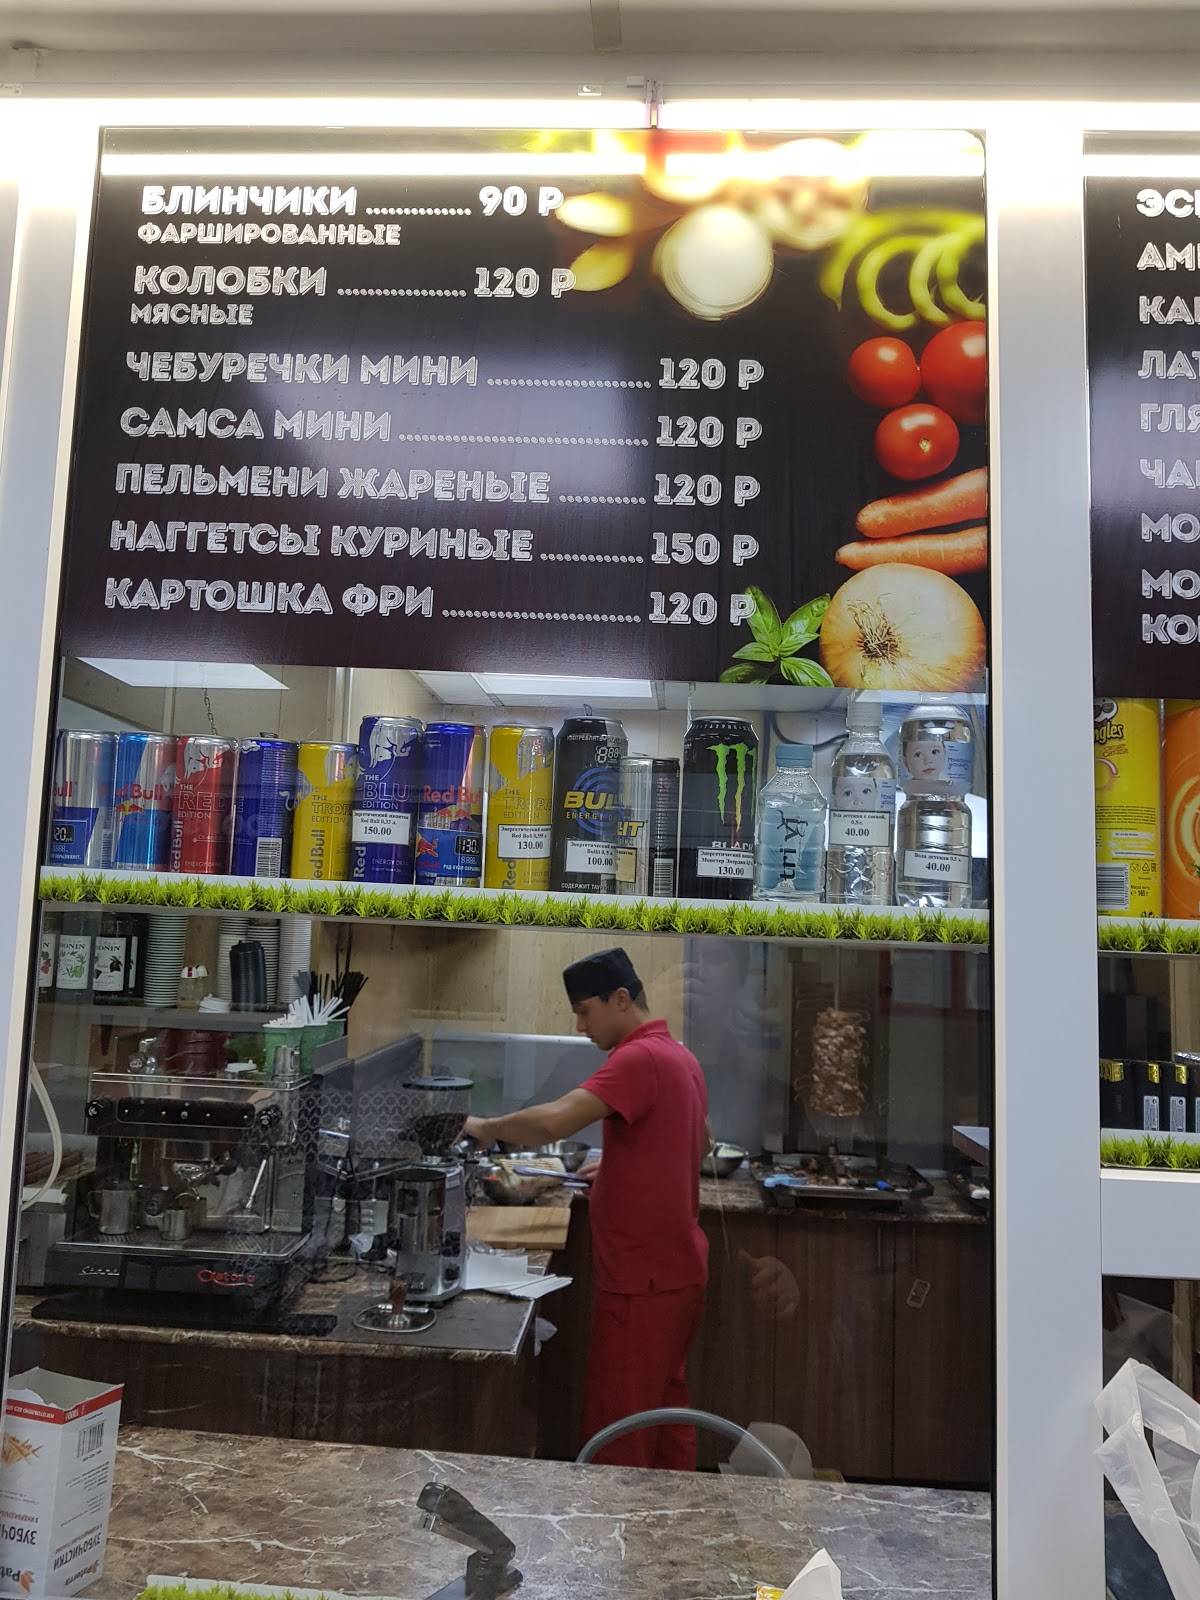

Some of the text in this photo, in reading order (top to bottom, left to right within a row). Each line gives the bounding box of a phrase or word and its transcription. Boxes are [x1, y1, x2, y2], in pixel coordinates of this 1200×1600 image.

[141, 186, 358, 216] БЛИНЧИКИ
[478, 185, 528, 216] 90
[1136, 188, 1200, 218] ЭС
[137, 222, 401, 245] ФАРШИРОВАННЫЕ
[1136, 242, 1200, 271] АМ
[133, 265, 328, 296] КОЛОБКИ
[474, 267, 540, 298] 120
[130, 303, 254, 325] МЯСНЫЕ
[1138, 295, 1200, 325] КА
[126, 351, 350, 384] ЧЕБУРЕЧКИ
[360, 354, 478, 386] МИНИ
[658, 358, 727, 389] 120
[119, 407, 264, 440] САМСА
[273, 409, 391, 442] МИНИ
[656, 415, 724, 447] 120
[115, 463, 329, 498] ПЕЛЬМЕНИ
[337, 467, 551, 503] ЖАРЕНЫЕ
[653, 473, 722, 506] 120
[110, 520, 322, 556] НАГГЕТСЫ
[330, 526, 534, 562] КУРИНЫЕ
[651, 532, 720, 566] 150
[105, 578, 334, 615] КАРТОШКА
[342, 583, 434, 617] ФРИ
[648, 591, 718, 625] 120
[1142, 613, 1200, 644] КО
[362, 801, 399, 810] EDITION
[423, 784, 454, 803] Red
[364, 826, 392, 835] 150.00
[518, 841, 544, 850] 130.00
[844, 828, 869, 837] 40.00
[354, 846, 367, 878] Red
[588, 857, 613, 866] 100.00
[718, 866, 744, 876] 130.00
[925, 862, 951, 872] 40.00
[53, 1533, 101, 1571] ЗУБОЧИСТКИ
